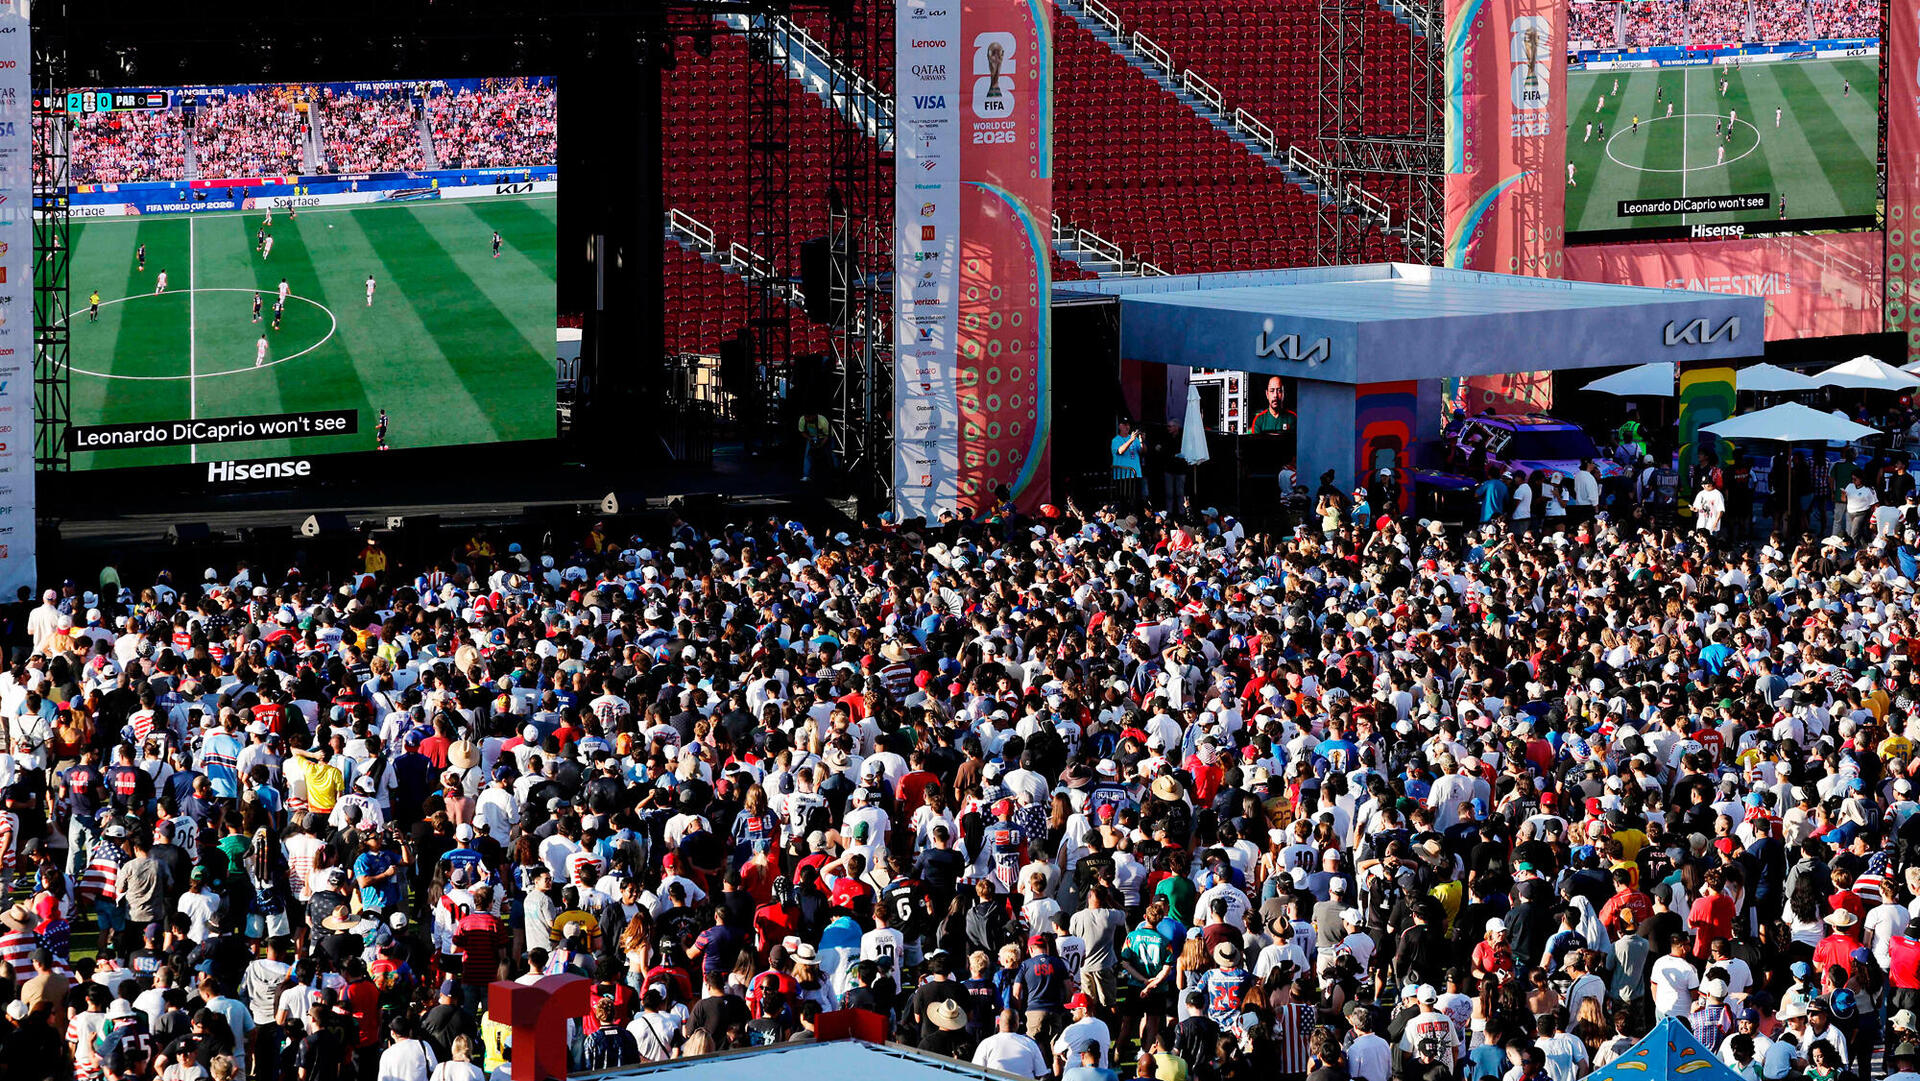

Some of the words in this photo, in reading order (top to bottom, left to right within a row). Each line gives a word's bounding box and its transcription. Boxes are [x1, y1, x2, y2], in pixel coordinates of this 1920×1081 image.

[912, 39, 946, 48] Lenovo
[912, 65, 946, 75] QATAR
[71, 97, 79, 109] 2
[100, 96, 108, 108] 0
[116, 95, 135, 106] PAR
[912, 96, 946, 109] VISA
[1523, 91, 1540, 100] FIFA
[985, 102, 1004, 110] FIFA
[973, 122, 999, 130] WORLD
[1001, 121, 1016, 130] CUP
[1511, 123, 1550, 137] 2026
[973, 131, 1016, 144] 2026
[496, 183, 533, 195] KIA
[163, 203, 189, 211] WORLD
[191, 202, 206, 210] CUP
[1624, 201, 1671, 214] Leonardo
[1673, 199, 1717, 212] DiCaprio
[1718, 197, 1745, 209] won't
[1747, 197, 1764, 206] see
[1691, 224, 1745, 238] Hisense
[914, 297, 940, 305] verizon
[1664, 316, 1741, 346] KIA
[1256, 331, 1330, 362] KIA
[77, 425, 168, 446] Leonardo
[173, 419, 255, 443] DiCaprio
[259, 416, 310, 435] won't
[315, 417, 346, 431] see
[208, 460, 311, 482] Hisense
[345, 797, 369, 809] USA
[177, 827, 194, 850] 26
[1295, 850, 1313, 874] 10
[450, 902, 470, 924] 10
[896, 897, 912, 919] 6
[1034, 964, 1054, 976] USA
[1213, 985, 1241, 1011] 26
